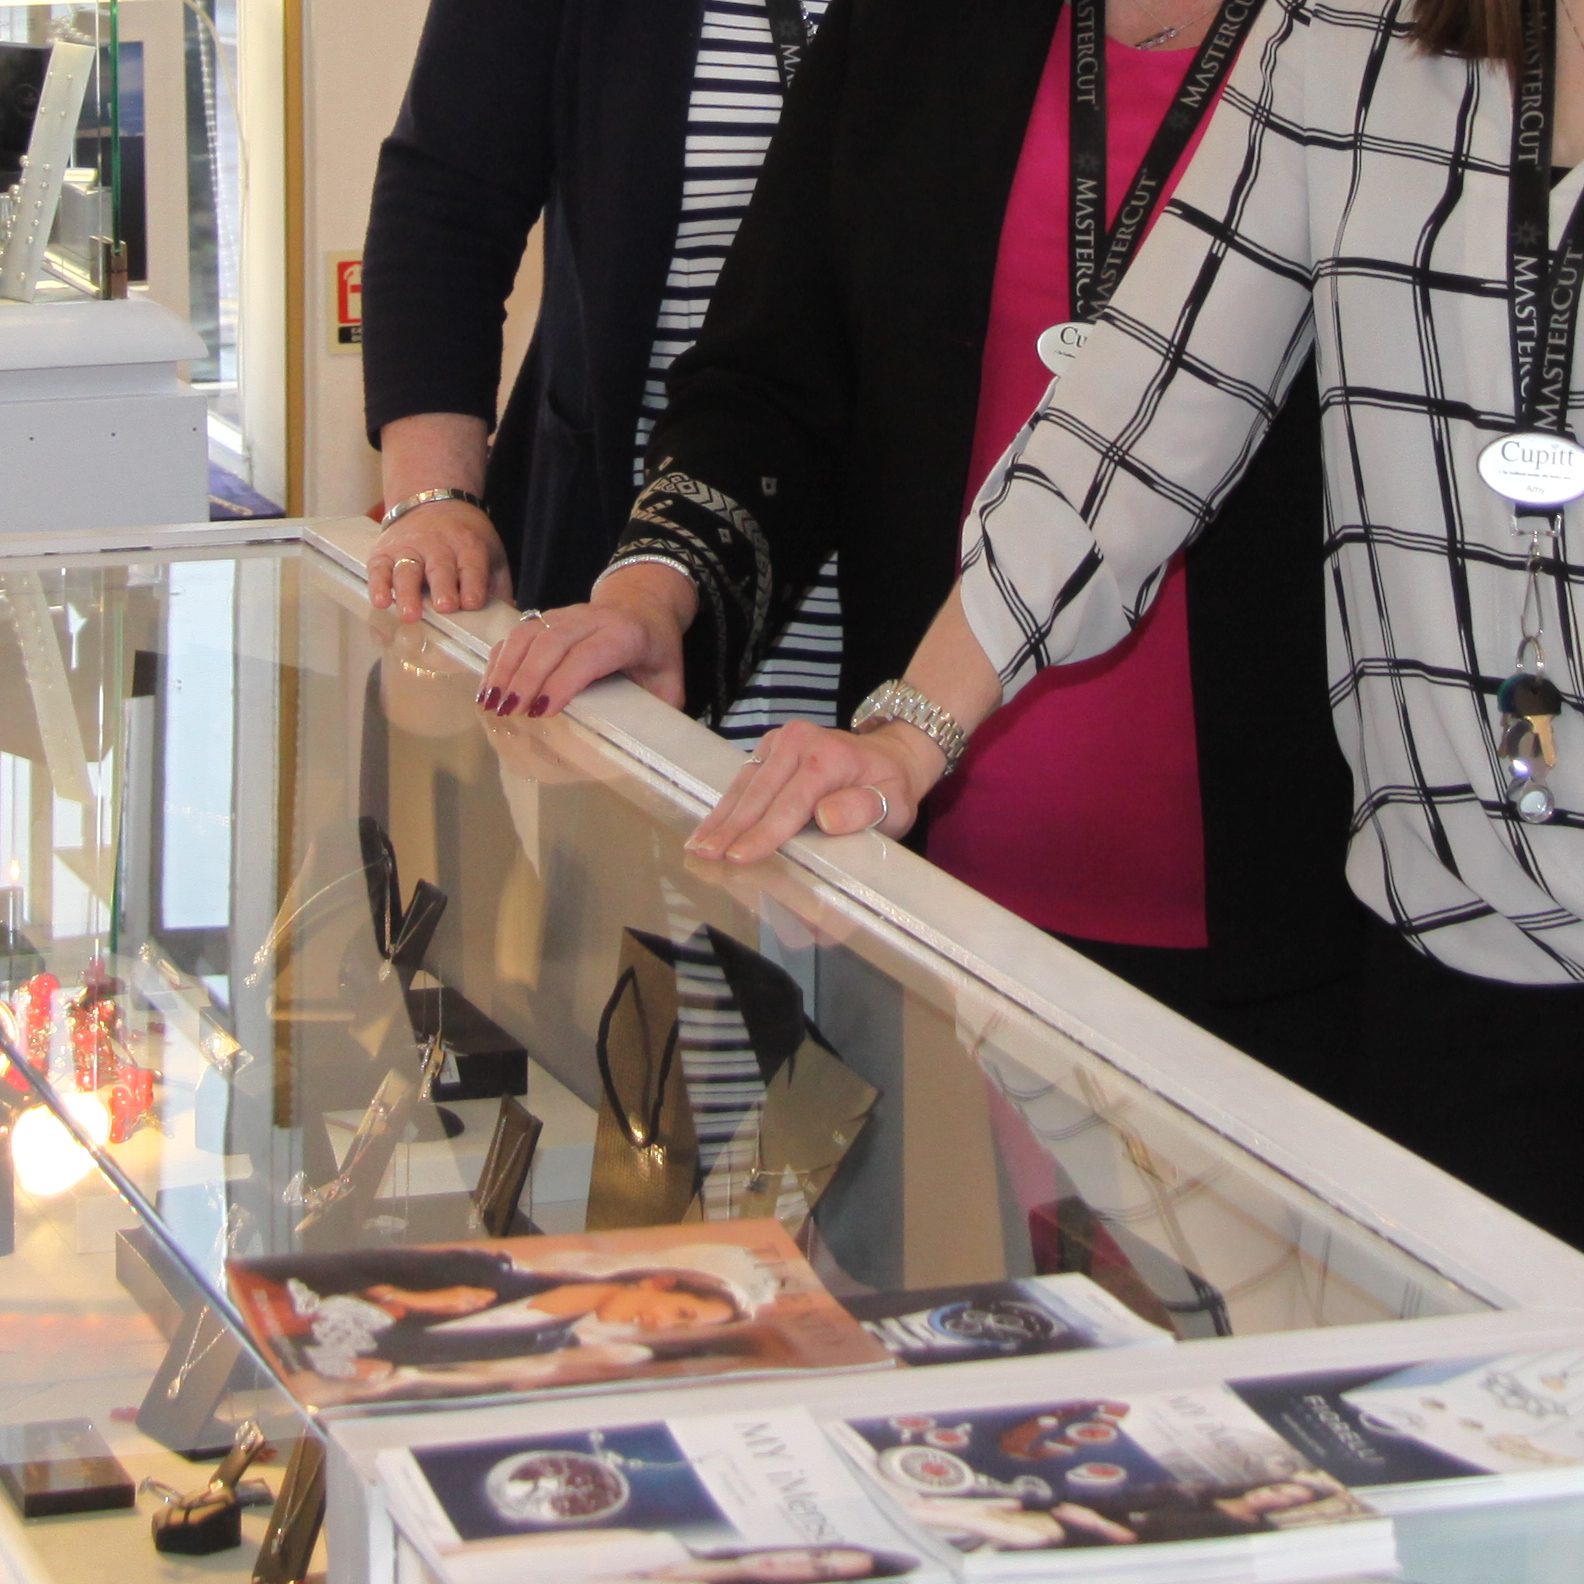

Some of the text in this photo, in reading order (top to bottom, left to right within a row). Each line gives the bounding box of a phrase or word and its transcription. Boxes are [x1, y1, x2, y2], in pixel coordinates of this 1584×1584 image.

[1534, 250, 1584, 431] MASTERCUT
[1501, 441, 1575, 471] Cupitt
[733, 1420, 796, 1461] MY
